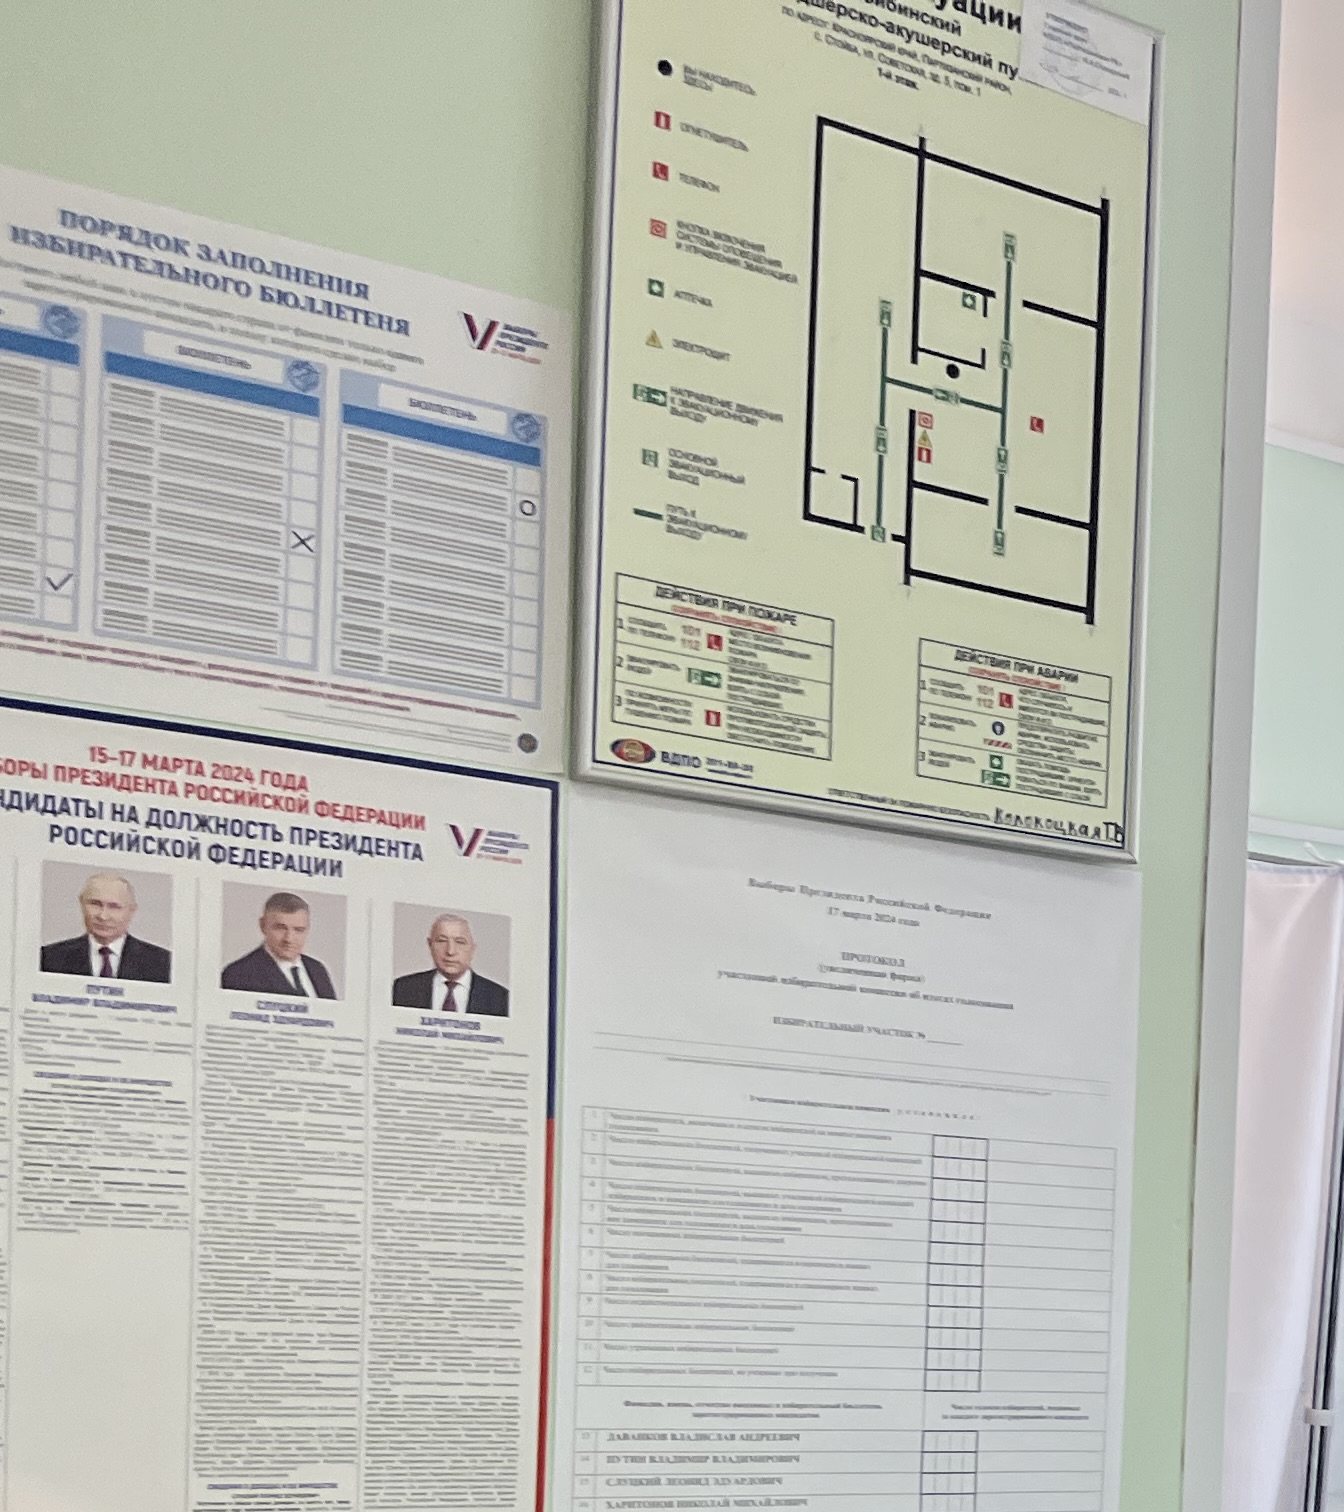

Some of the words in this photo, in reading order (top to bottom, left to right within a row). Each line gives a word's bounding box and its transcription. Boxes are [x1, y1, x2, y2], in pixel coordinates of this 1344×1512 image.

[9, 225, 252, 298] ИЗБИРАТЕЛЬНОГО
[260, 284, 411, 337] БЮЛЛЕТЕНЯ
[58, 208, 190, 257] ПОРЯДОК
[197, 242, 370, 301] ЗАПОЛНЕНИЯ
[954, 649, 1011, 670] ДЕЙСТВИЯ
[1014, 660, 1034, 675] ПРИ
[1037, 666, 1079, 684] АВАРИИ
[54, 764, 178, 798] ПРЕЗИДЕНТА
[184, 783, 309, 815] РОССИЙСКОЙ
[314, 801, 427, 831] ФЕДЕРАЦИИ
[141, 752, 206, 778] МАРТА
[211, 763, 255, 785] 2024
[259, 769, 309, 793] ГОДА
[50, 824, 201, 861] РОССИЙСКОЙ
[207, 842, 343, 878] ФЕДЕРАЦИИ
[111, 803, 139, 824] НА
[145, 807, 284, 843] ДОЛЖНОСТЬ
[289, 826, 424, 862] ПРЕЗИДЕНТА
